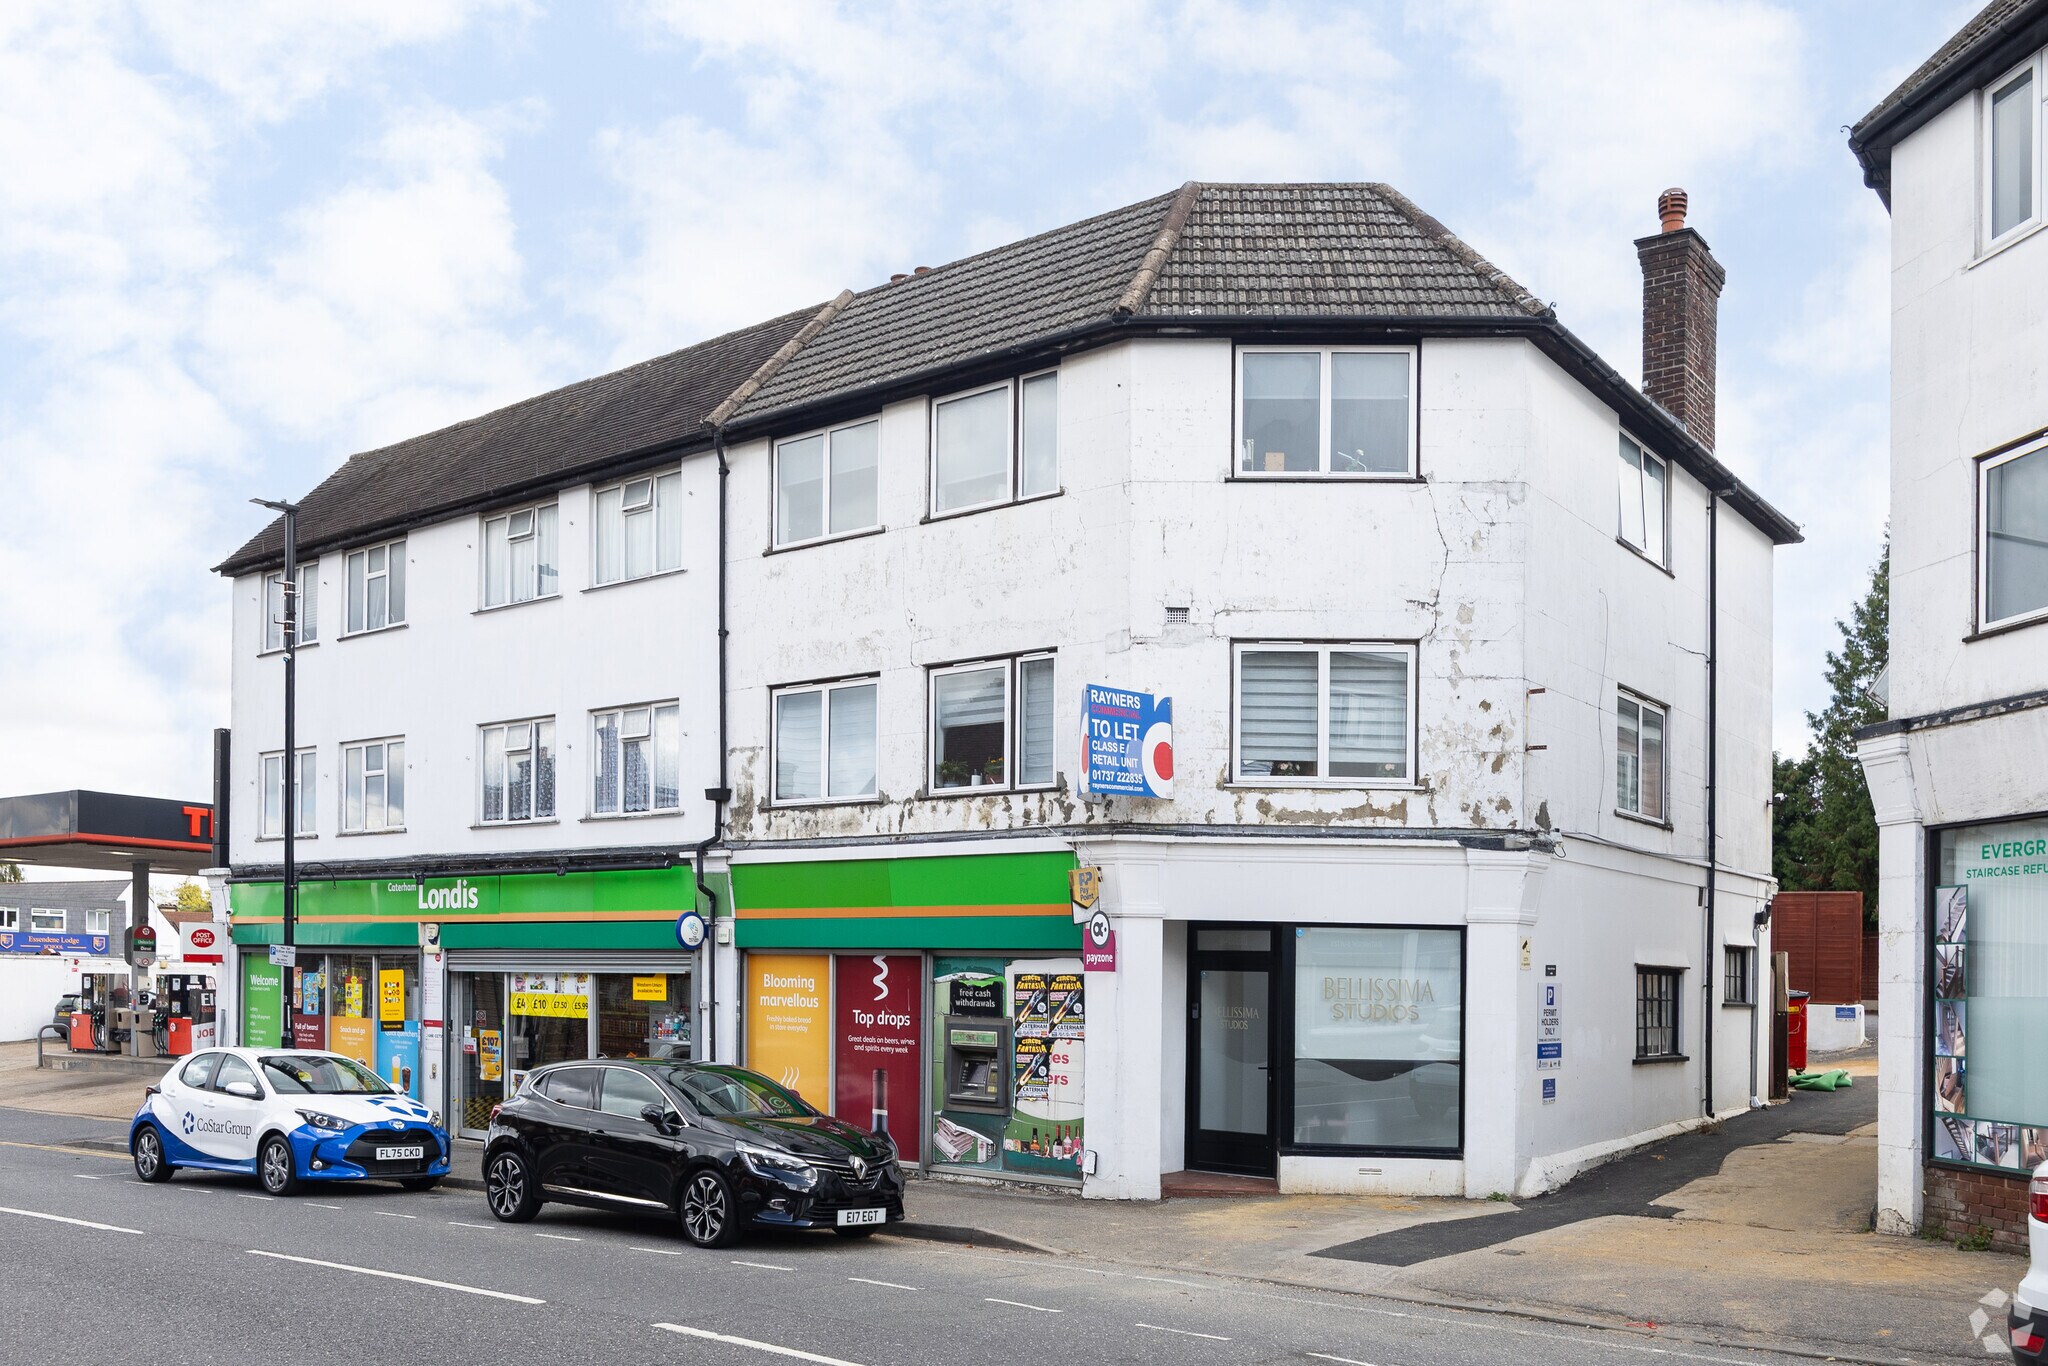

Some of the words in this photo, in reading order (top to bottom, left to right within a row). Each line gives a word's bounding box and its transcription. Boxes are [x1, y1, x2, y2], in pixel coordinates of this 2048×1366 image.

[1090, 689, 1141, 709] RAYNERS
[1091, 704, 1141, 720] COMMERCIAL
[1091, 718, 1111, 738] TO
[1114, 721, 1140, 741] LET
[1092, 740, 1118, 753] CLASS
[1119, 743, 1125, 754] E
[1092, 754, 1120, 767] RETAIL
[1121, 757, 1139, 769] UNIT
[1092, 769, 1115, 782] 01737
[1116, 772, 1143, 784] 222835
[1092, 782, 1144, 792] raynerscommercial.com
[1982, 840, 2047, 860] EVERGR
[1966, 865, 2020, 879] STAIRCASE
[387, 882, 417, 892] Caterham
[1080, 887, 1089, 896] Pay
[418, 879, 479, 910] Londis
[1080, 893, 1095, 901] Point
[28, 935, 60, 944] Essendene
[61, 936, 80, 945] Lodge
[192, 937, 214, 945] OFFICE
[1086, 953, 1114, 965] payzone
[249, 974, 279, 986] Welcome
[763, 973, 815, 993] Blooming
[1016, 981, 1047, 990] FANTASIA
[1050, 981, 1083, 990] FANTASIA
[959, 988, 974, 998] free
[975, 989, 992, 998] cash
[1323, 976, 1435, 1003] BELLISSIMA
[516, 997, 526, 1009] £4
[533, 1000, 547, 1010] £10
[554, 1001, 568, 1009] £7.50
[574, 1002, 589, 1010] £5.99
[760, 993, 819, 1008] marvellous
[955, 998, 996, 1009] withdrawals
[1331, 1002, 1421, 1022] STUDIOS
[1543, 1008, 1558, 1018] PERMIT
[766, 1014, 782, 1024] Freshly
[782, 1015, 797, 1023] baked
[797, 1016, 812, 1024] bread
[852, 1009, 875, 1029] Top
[877, 1010, 911, 1030] drops
[1541, 1018, 1560, 1027] HOLDERS
[786, 1025, 809, 1033] everyday
[1544, 1027, 1556, 1036] ONLY
[482, 1037, 499, 1047] £107
[847, 1034, 863, 1043] Great
[862, 1036, 877, 1044] deals
[884, 1037, 900, 1045] beers,
[900, 1038, 916, 1046] wines
[864, 1045, 880, 1053] spirits
[880, 1046, 895, 1055] every
[894, 1046, 909, 1054] week
[1016, 1044, 1047, 1053] FANTASIA
[196, 1117, 225, 1133] CoStar
[224, 1120, 252, 1140] Group
[380, 1148, 402, 1158] FL75
[404, 1147, 420, 1157] CKD
[846, 1211, 861, 1223] E17
[862, 1210, 879, 1222] EGT
